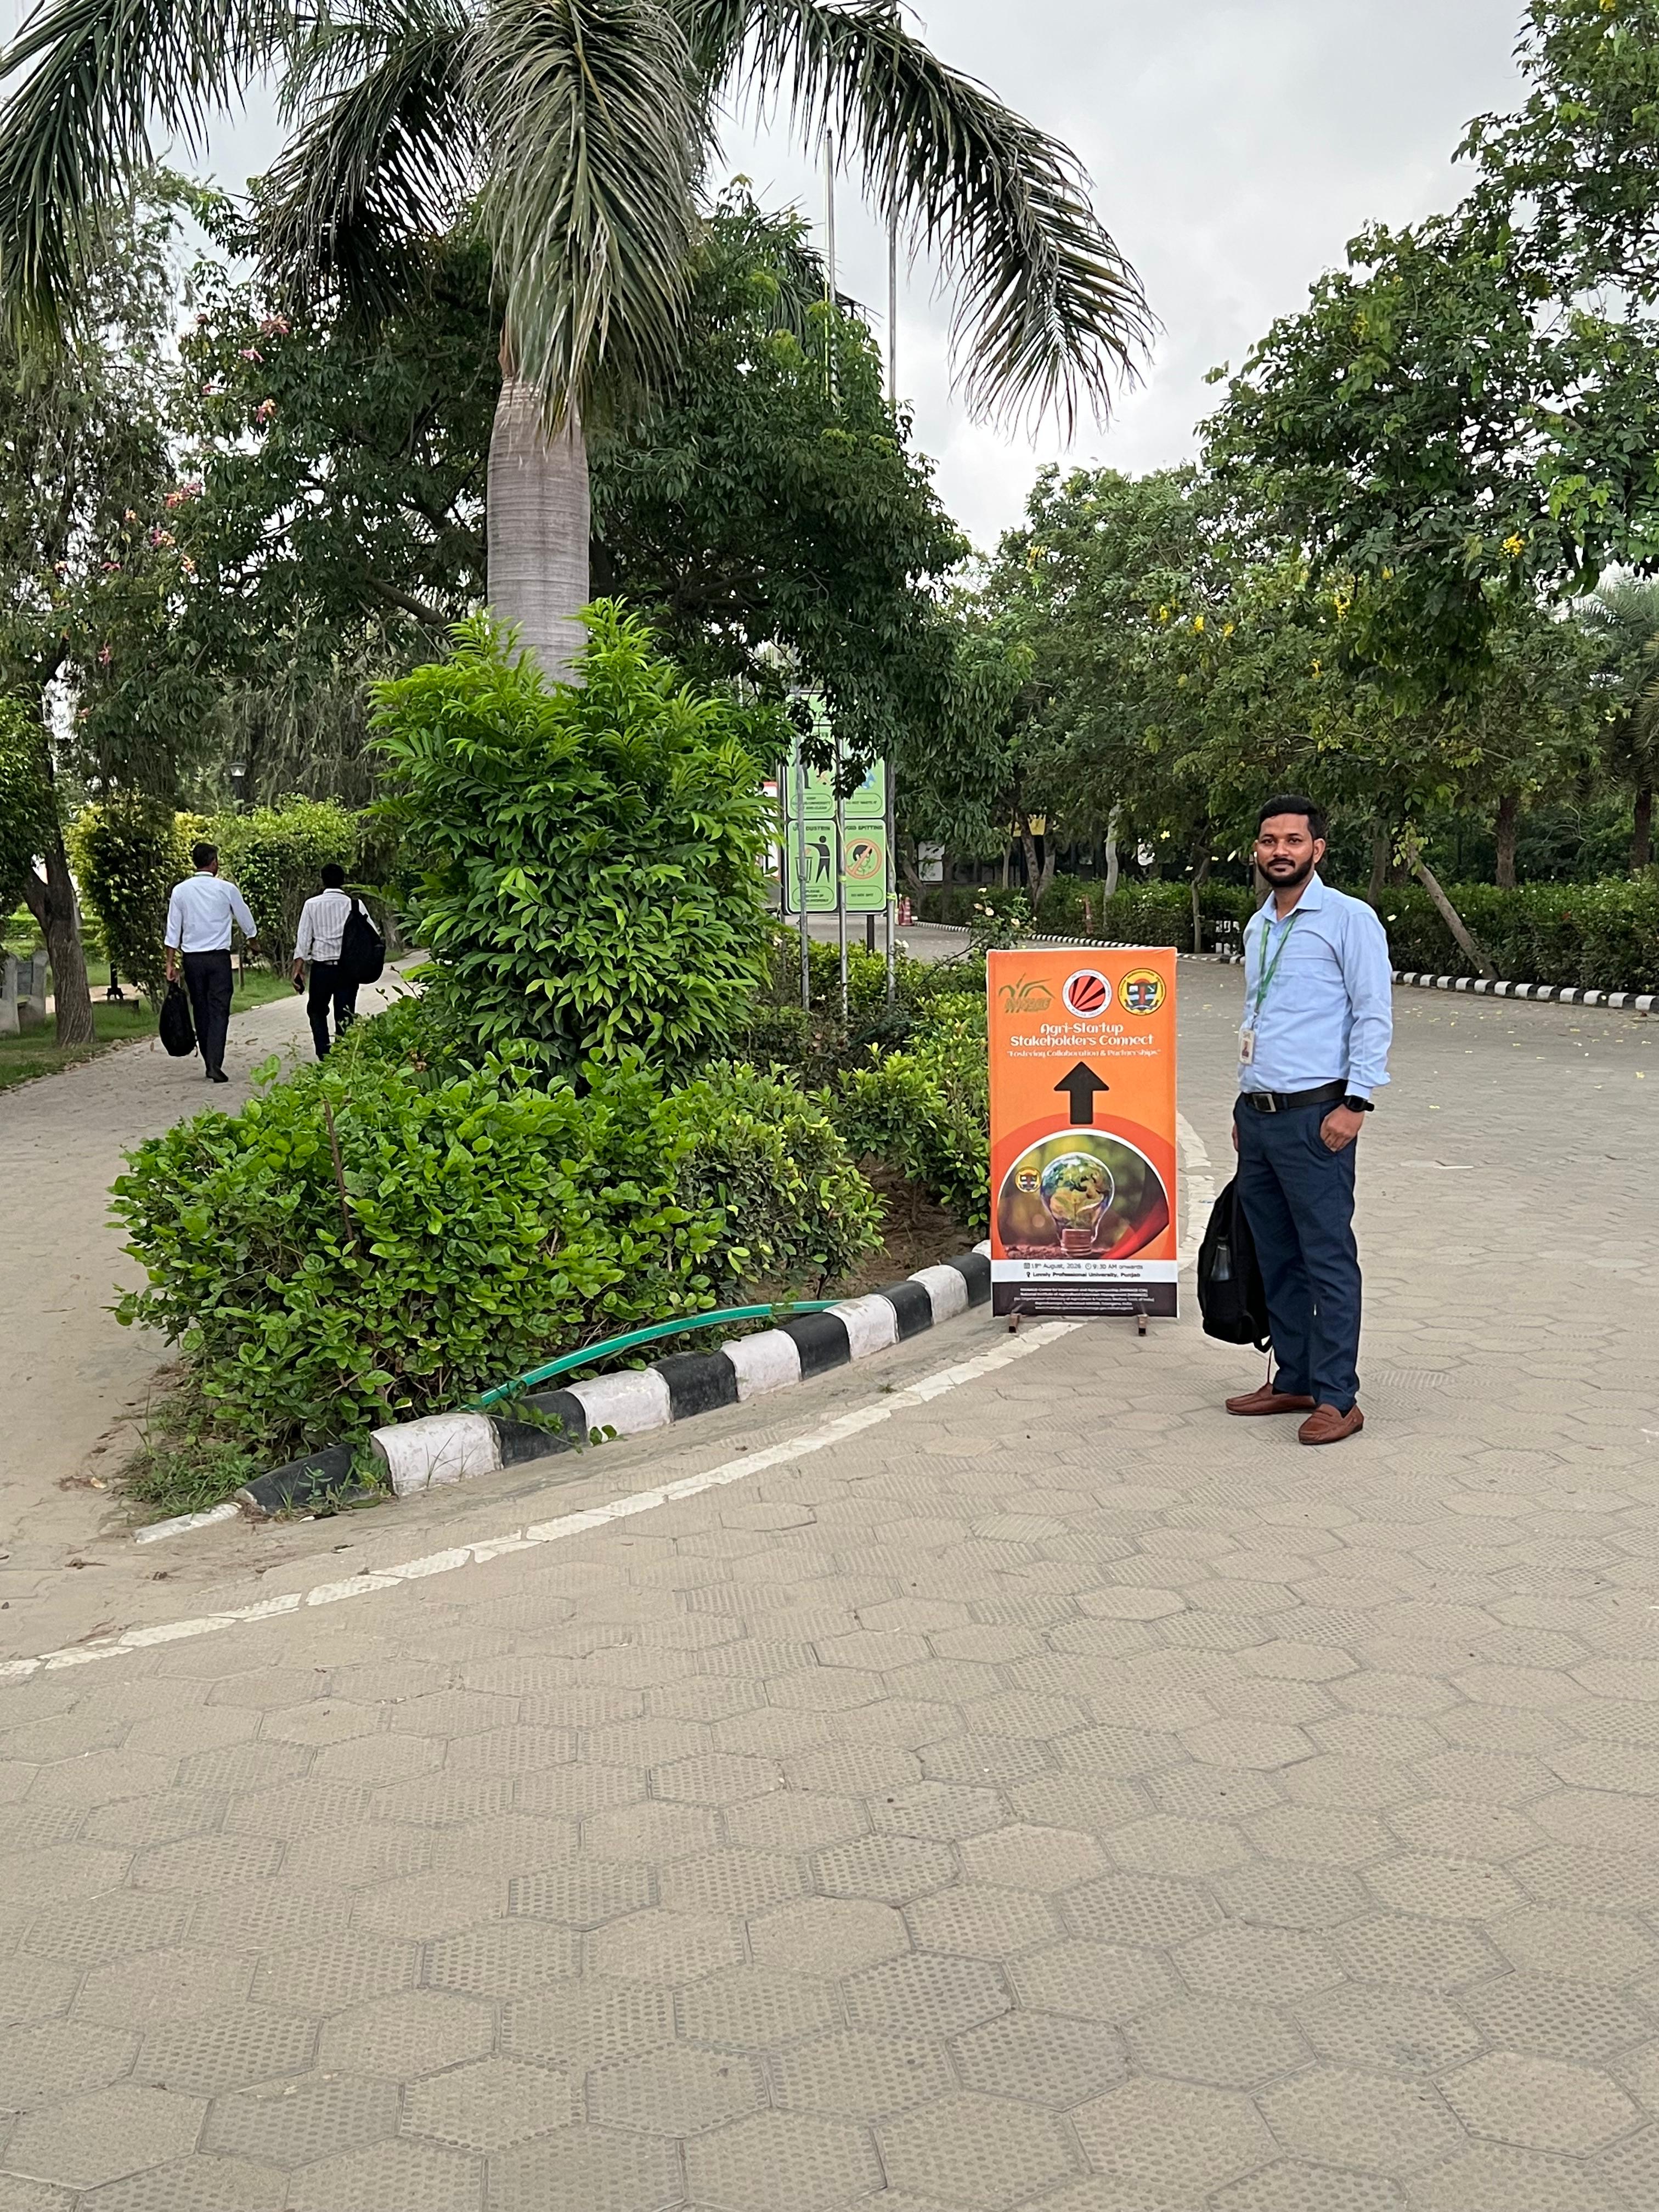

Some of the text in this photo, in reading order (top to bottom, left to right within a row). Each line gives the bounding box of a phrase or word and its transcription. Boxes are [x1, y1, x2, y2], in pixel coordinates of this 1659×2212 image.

[1040, 1022, 1124, 1037] Agri-Startup
[1010, 1034, 1154, 1047] Stakeholders Connect
[1046, 1049, 1099, 1057] Collaboration
